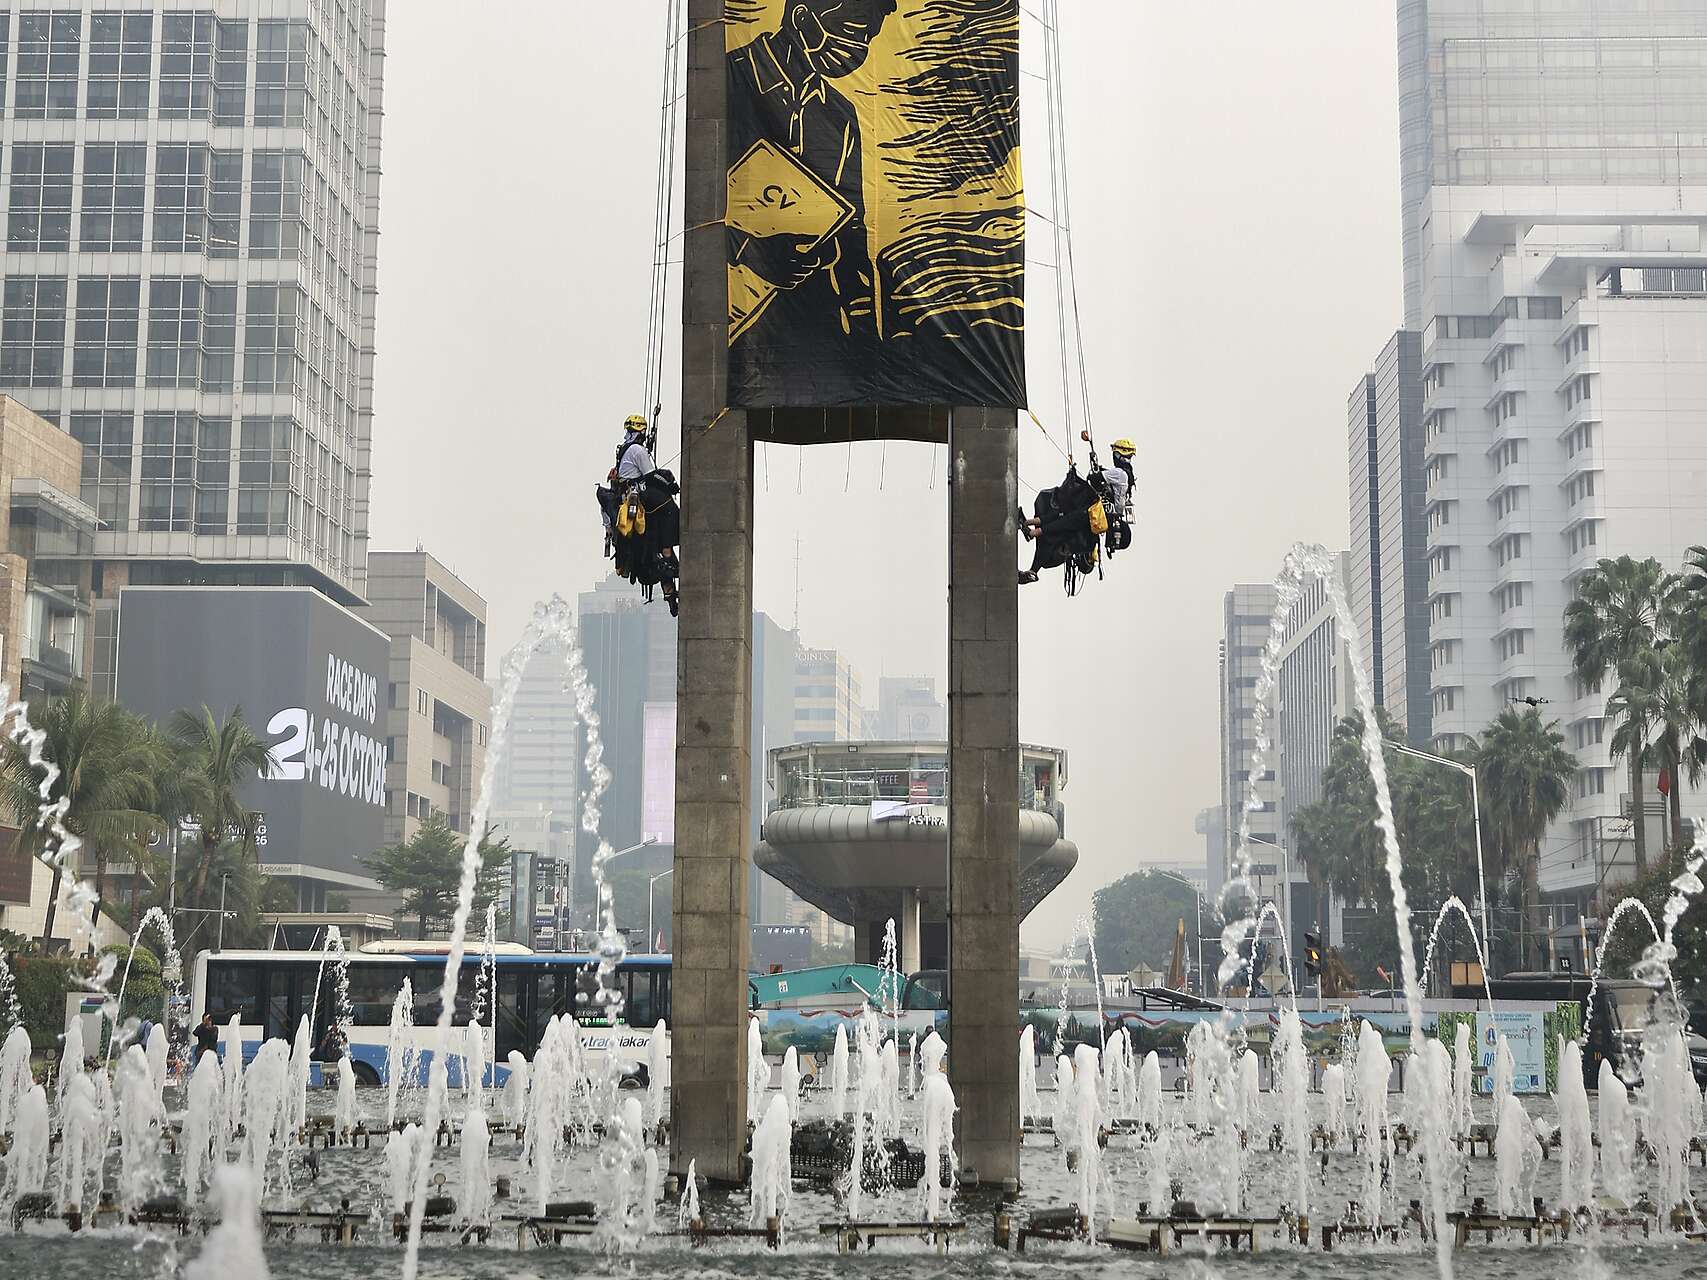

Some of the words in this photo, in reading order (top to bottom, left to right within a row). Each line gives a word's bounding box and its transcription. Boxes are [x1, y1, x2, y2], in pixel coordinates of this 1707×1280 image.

[763, 184, 797, 210] CV
[326, 653, 353, 713] RACE
[352, 667, 377, 725] DAYS
[908, 815, 946, 827] ASTRA
